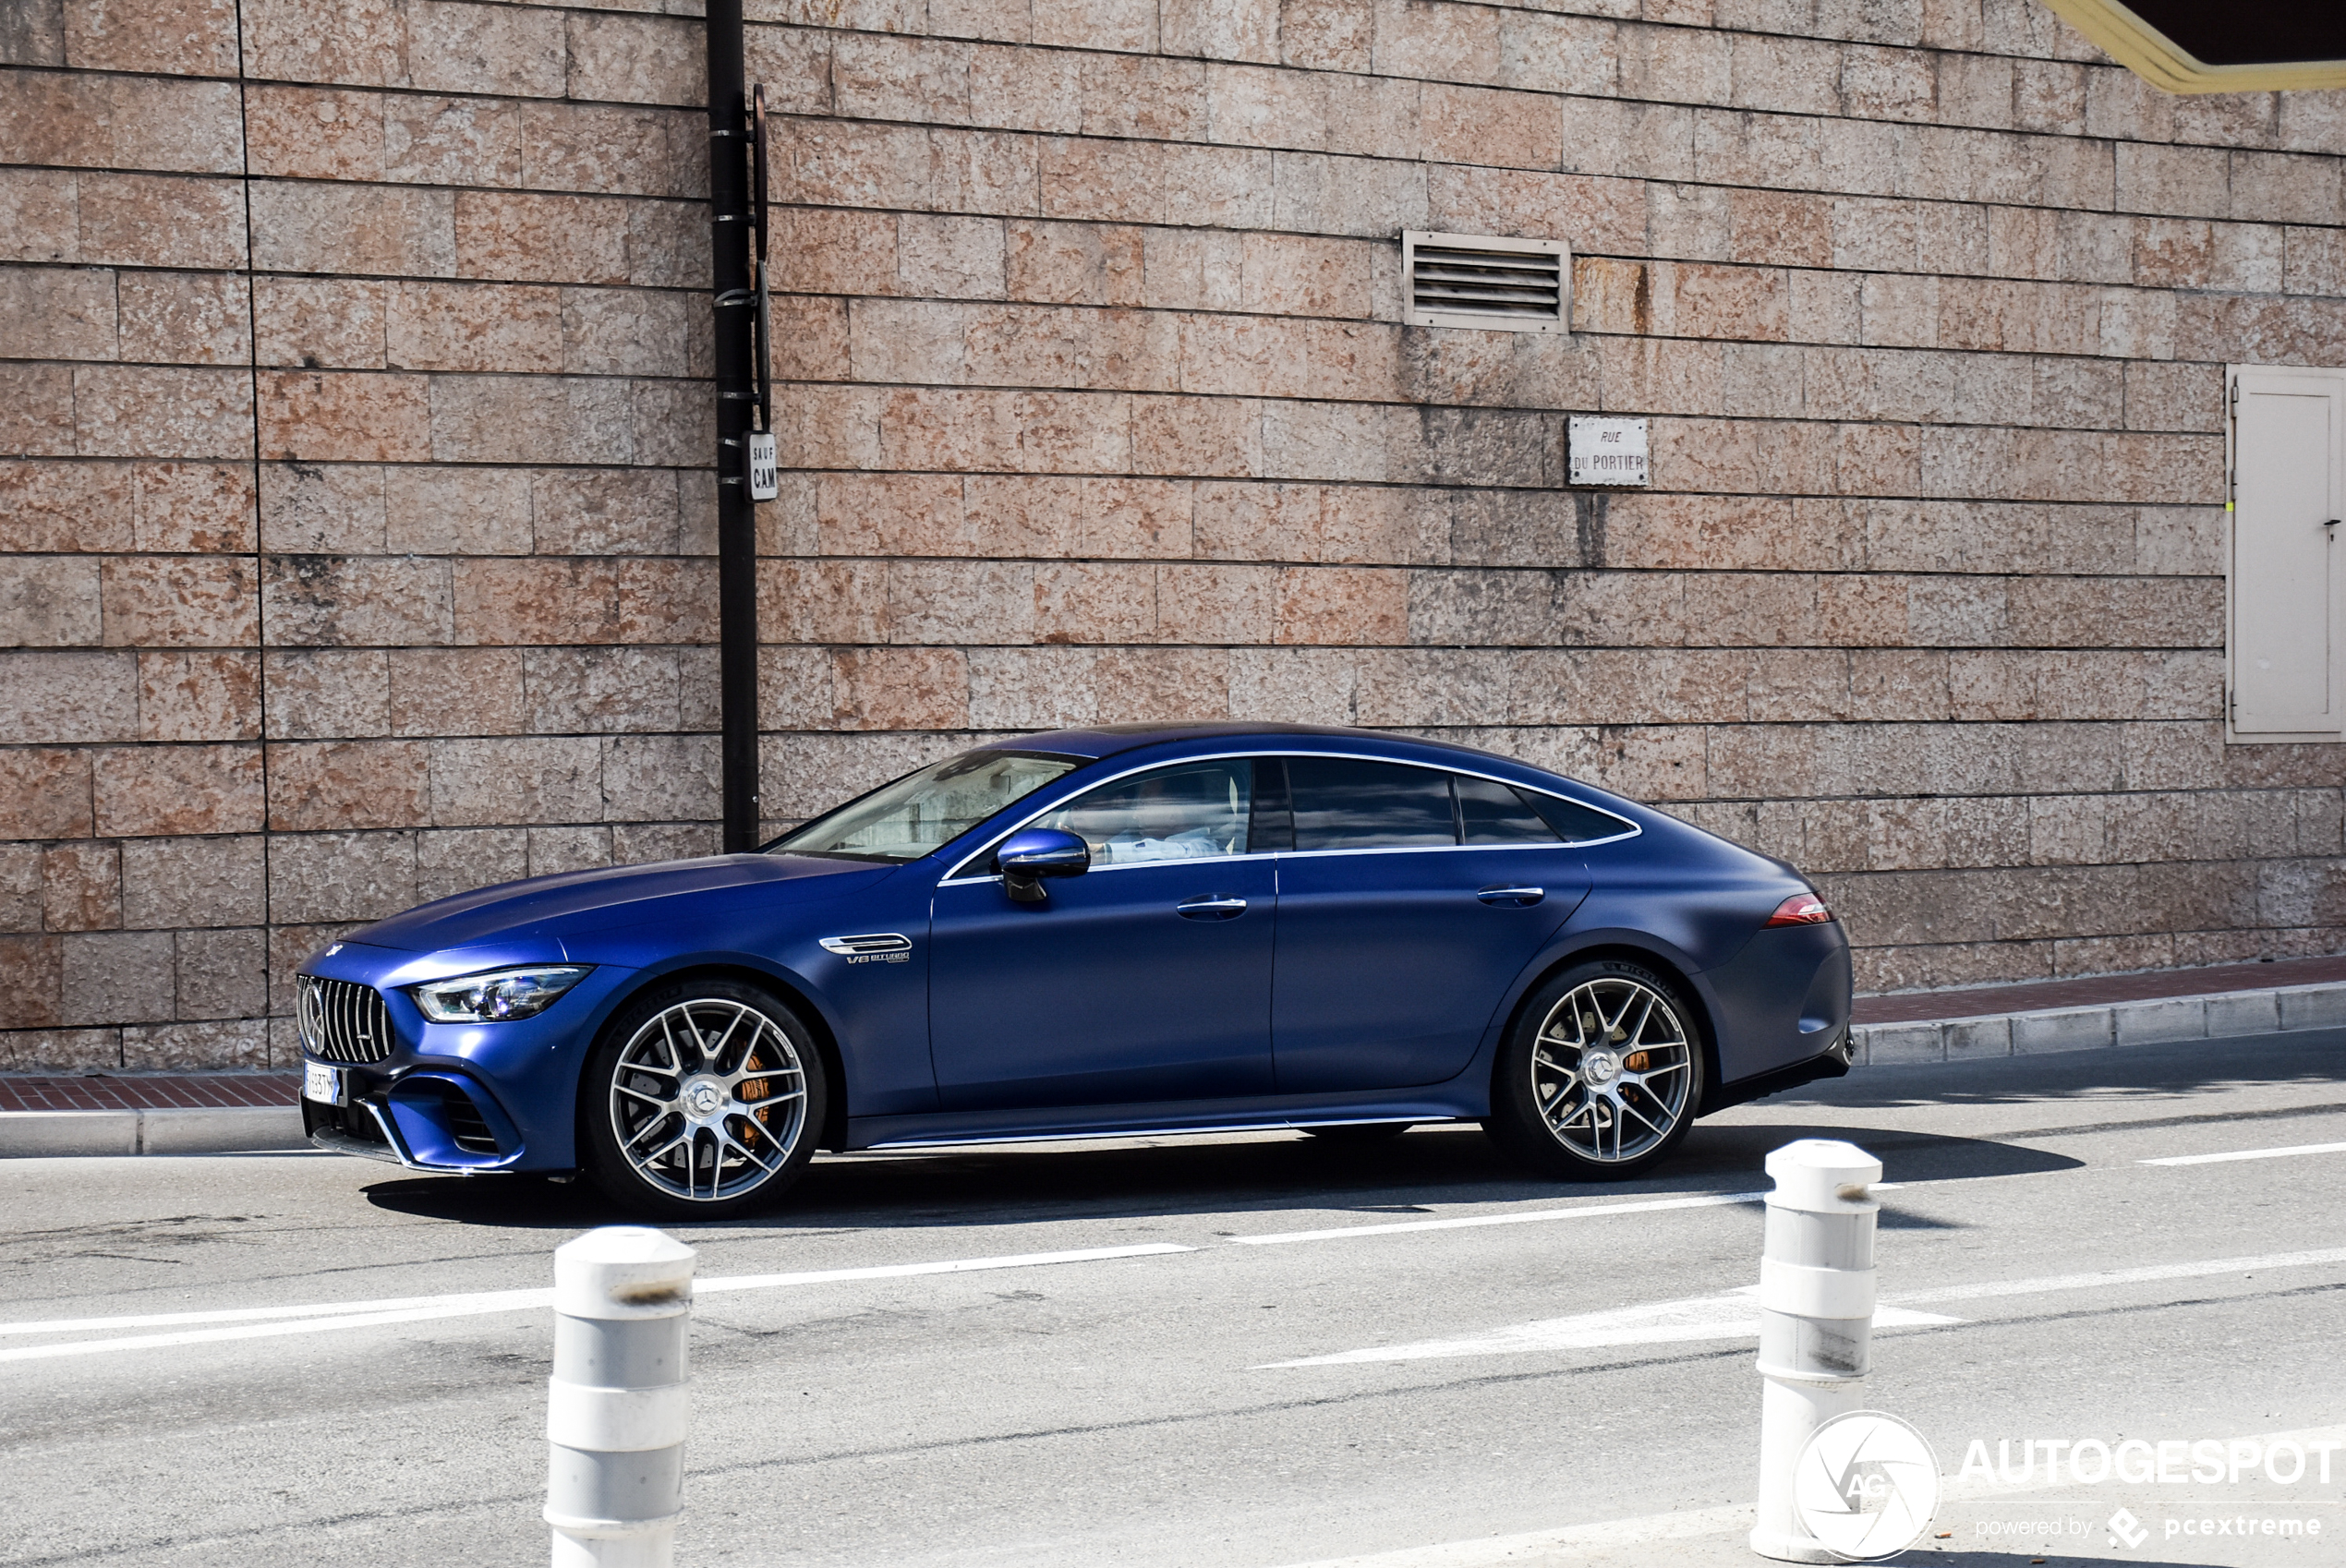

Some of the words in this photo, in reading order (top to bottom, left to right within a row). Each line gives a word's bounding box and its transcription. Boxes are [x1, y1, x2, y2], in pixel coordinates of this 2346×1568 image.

[1601, 431, 1622, 443] RUE
[754, 447, 773, 461] SAUF
[1574, 457, 1589, 470] DU
[1593, 454, 1643, 470] PORTIER
[847, 956, 869, 964] V8
[1619, 964, 1675, 998] MICHELIN
